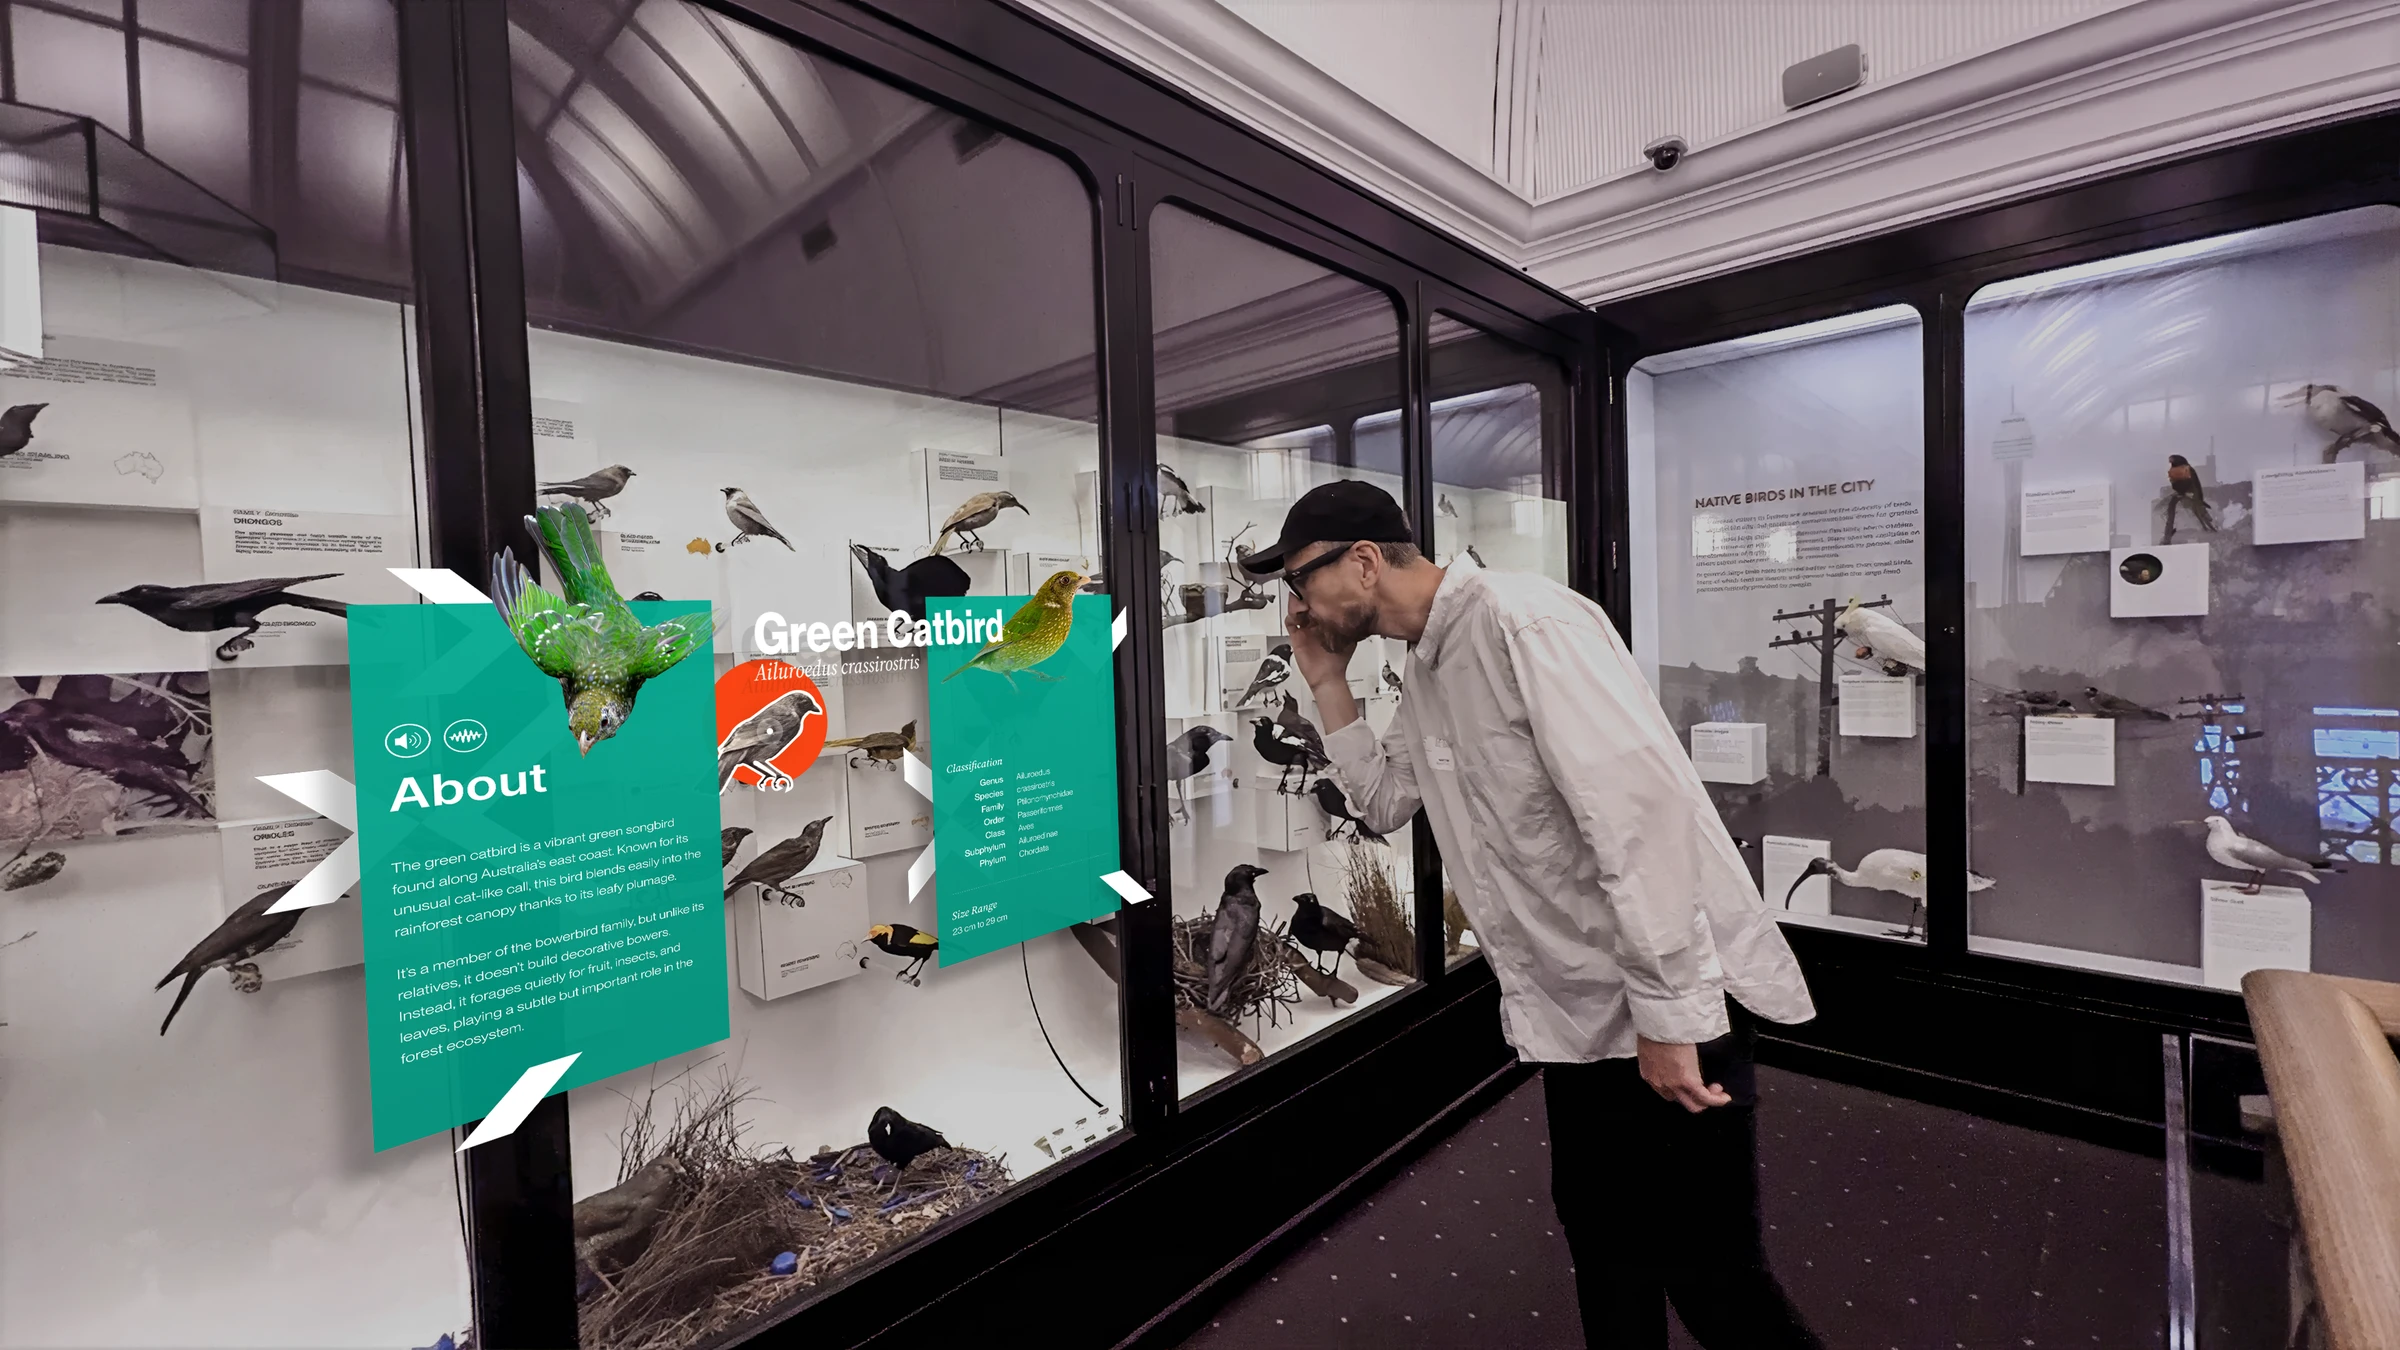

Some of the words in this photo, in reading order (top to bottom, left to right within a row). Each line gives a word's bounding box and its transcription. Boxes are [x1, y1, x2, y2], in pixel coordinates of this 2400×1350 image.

[1695, 494, 1742, 509] NATIVE
[1745, 489, 1787, 505] BIRDS
[1789, 487, 1805, 500] IN
[1808, 483, 1838, 498] THE
[1841, 479, 1876, 494] CITY
